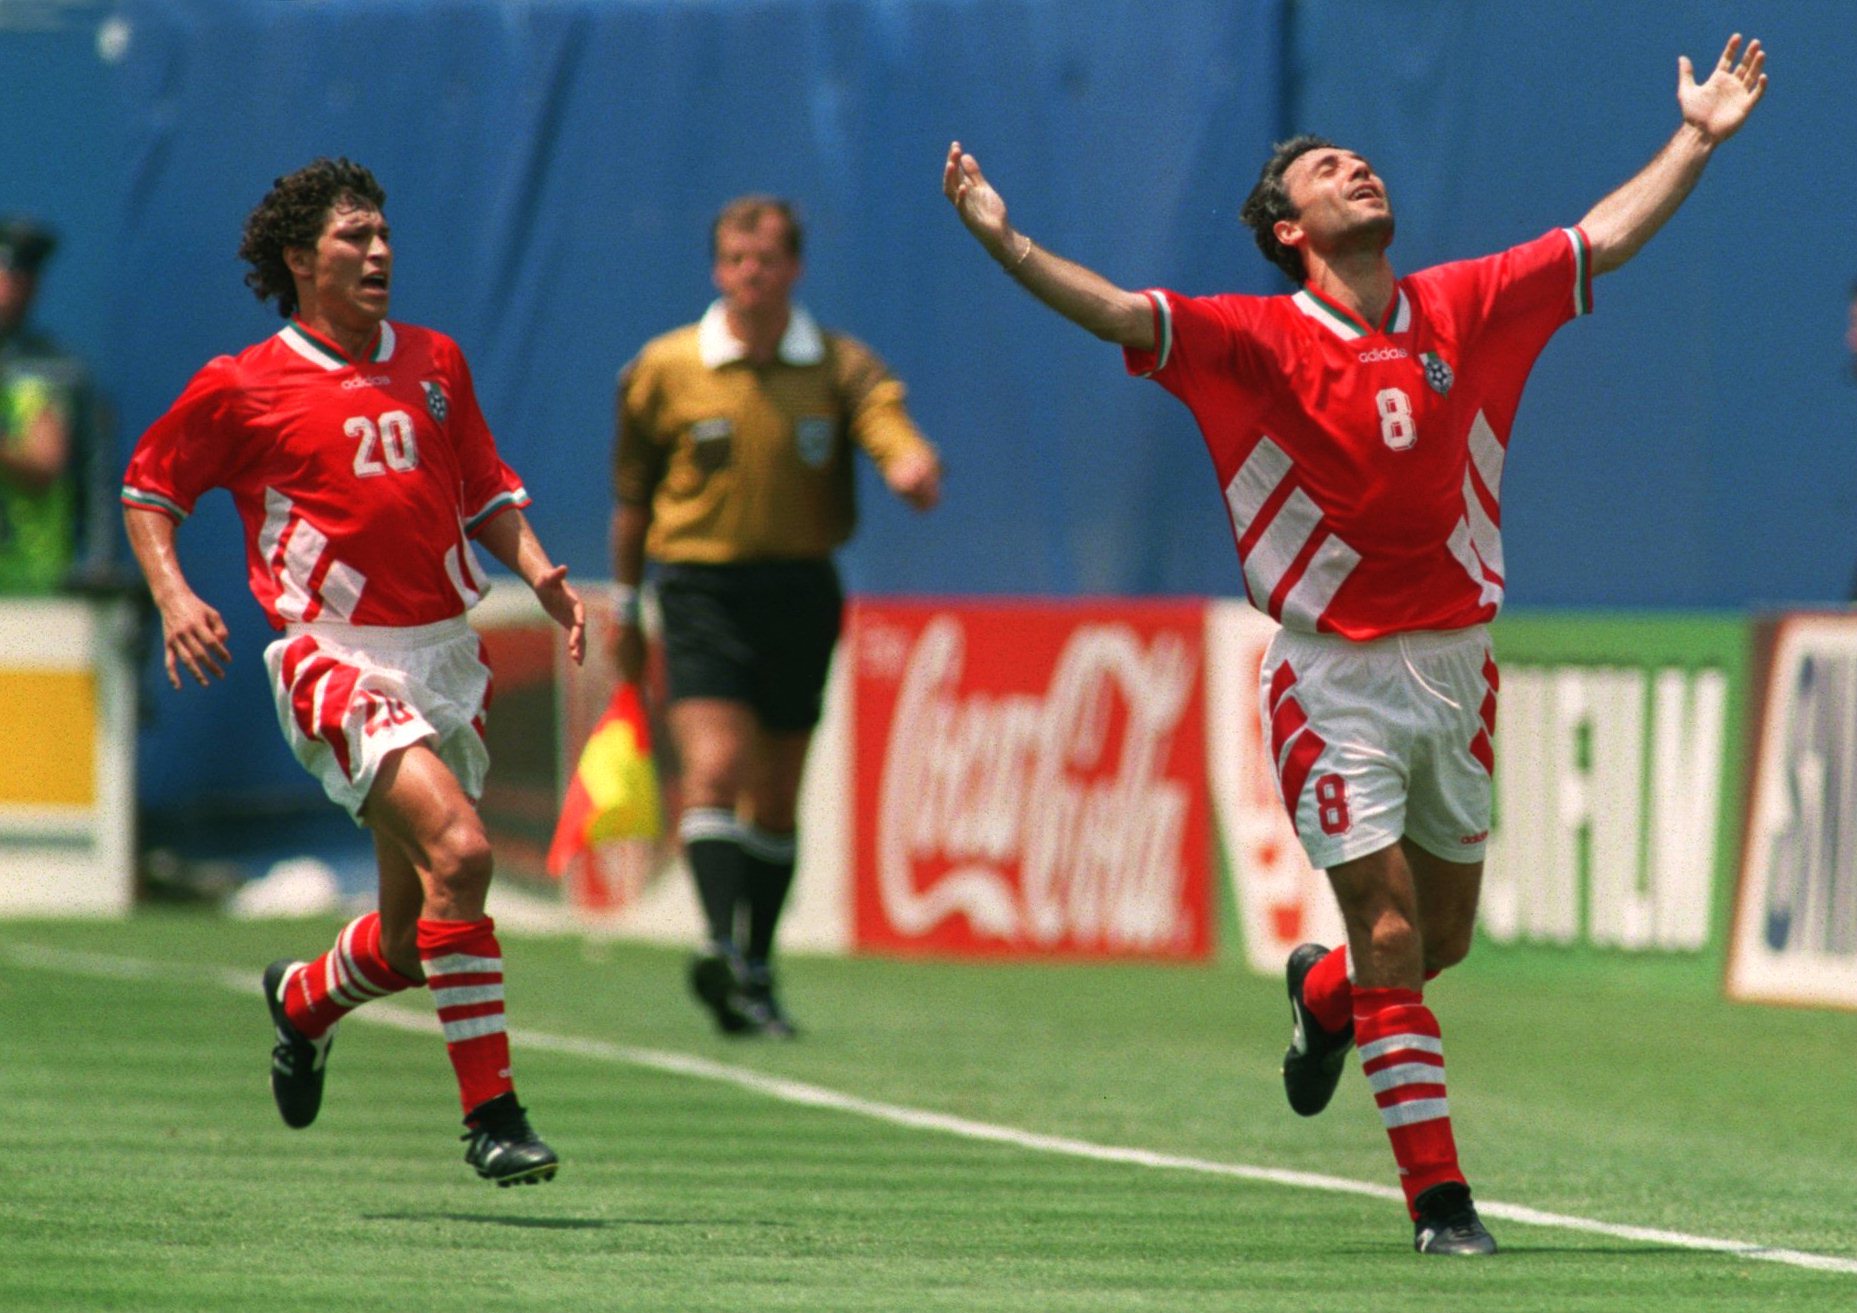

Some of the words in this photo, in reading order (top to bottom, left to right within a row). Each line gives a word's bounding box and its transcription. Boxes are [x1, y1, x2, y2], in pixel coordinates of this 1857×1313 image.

[343, 410, 418, 478] 20
[1375, 387, 1418, 452] 8
[1315, 772, 1353, 837] 8
